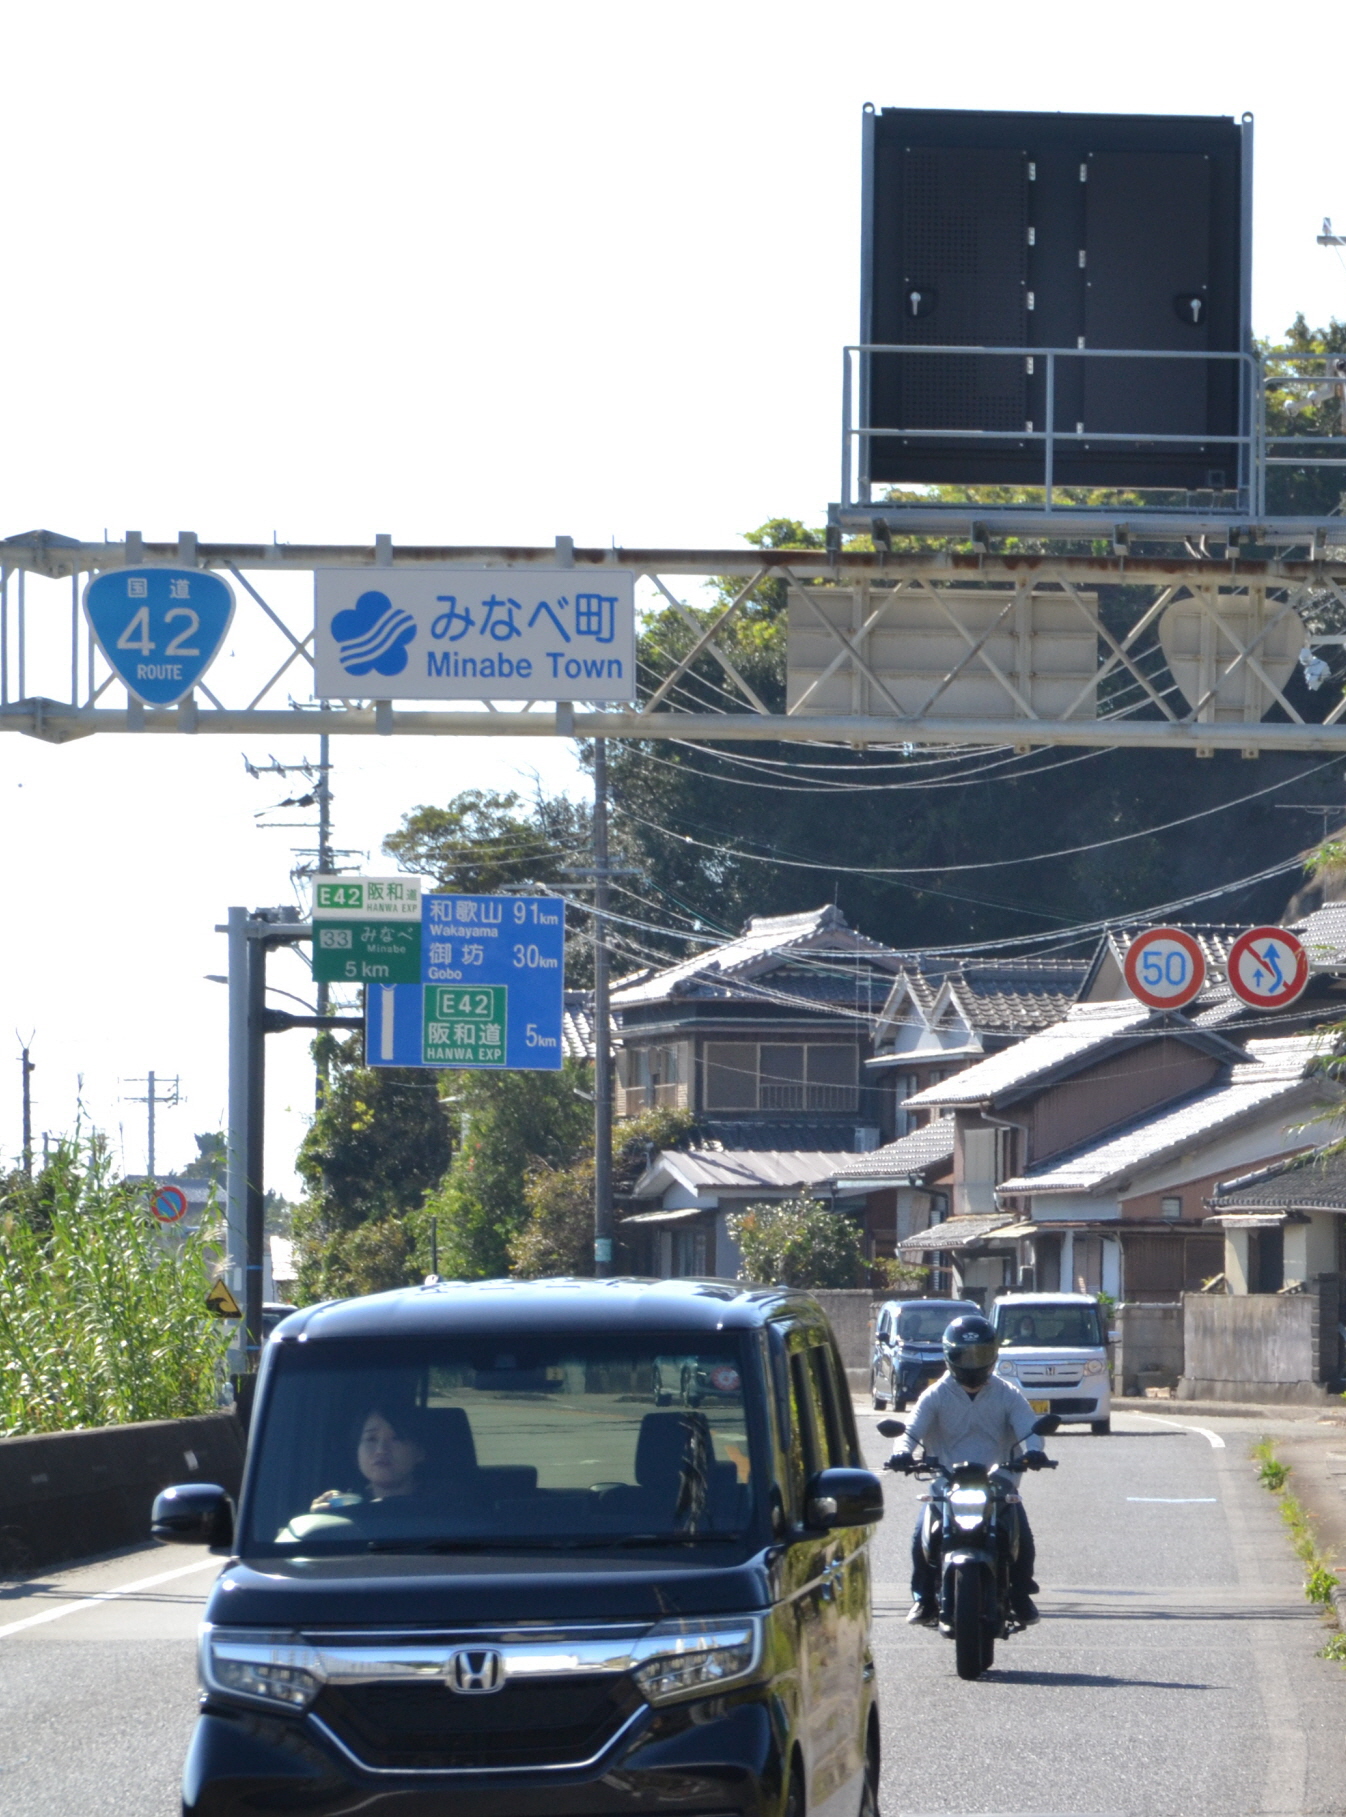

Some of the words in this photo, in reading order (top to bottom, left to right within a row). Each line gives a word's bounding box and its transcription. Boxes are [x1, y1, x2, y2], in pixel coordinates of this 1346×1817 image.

[127, 578, 191, 600] 国道
[430, 594, 619, 643] みなべ町
[116, 607, 201, 657] 42
[137, 664, 184, 681] ROUTE
[427, 651, 533, 679] Minabe
[546, 652, 624, 680] Town
[320, 887, 360, 905] E42
[366, 903, 398, 912] HANWA
[401, 904, 417, 913] EXP
[430, 900, 502, 923] 和歌山
[323, 931, 349, 947] 33
[360, 926, 413, 943] みなべ
[429, 924, 499, 939] Wakayama
[367, 944, 406, 954] Minabe
[429, 942, 484, 966] 御坊
[428, 966, 462, 980] Gobo
[1143, 951, 1187, 986] 50
[443, 994, 488, 1014] E42
[428, 1022, 502, 1046] 阪和道
[427, 1048, 474, 1060] HANWA
[478, 1048, 502, 1061] EXP
